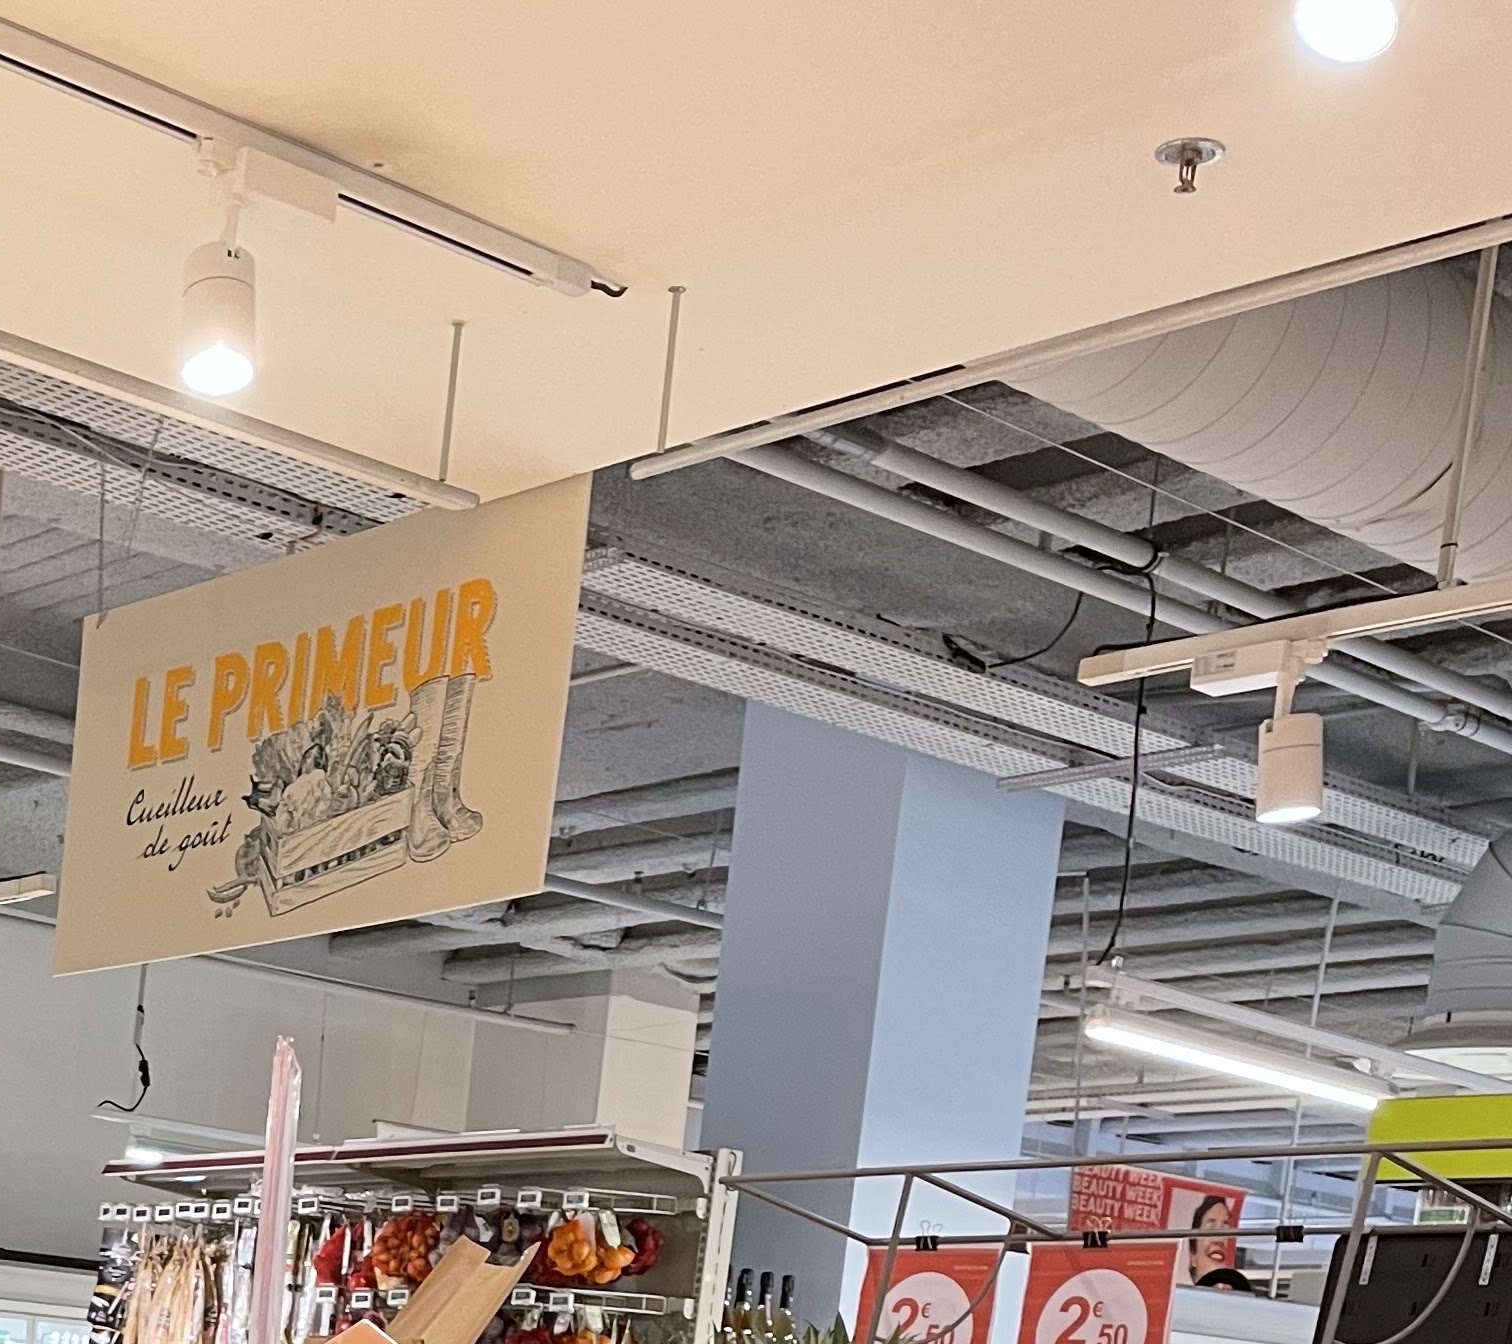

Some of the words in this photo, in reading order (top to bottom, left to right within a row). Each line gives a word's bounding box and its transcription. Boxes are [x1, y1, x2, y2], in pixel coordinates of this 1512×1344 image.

[126, 665, 196, 770] LE
[205, 577, 498, 753] PRIMEUR
[125, 775, 228, 828] Cueilleur
[137, 825, 172, 860] de
[168, 812, 234, 872] goût
[1071, 1192, 1123, 1217] BEAUTY
[1123, 1201, 1161, 1225] WEEK
[1072, 1175, 1125, 1199] BEAUTY
[1125, 1186, 1162, 1205] WEEK
